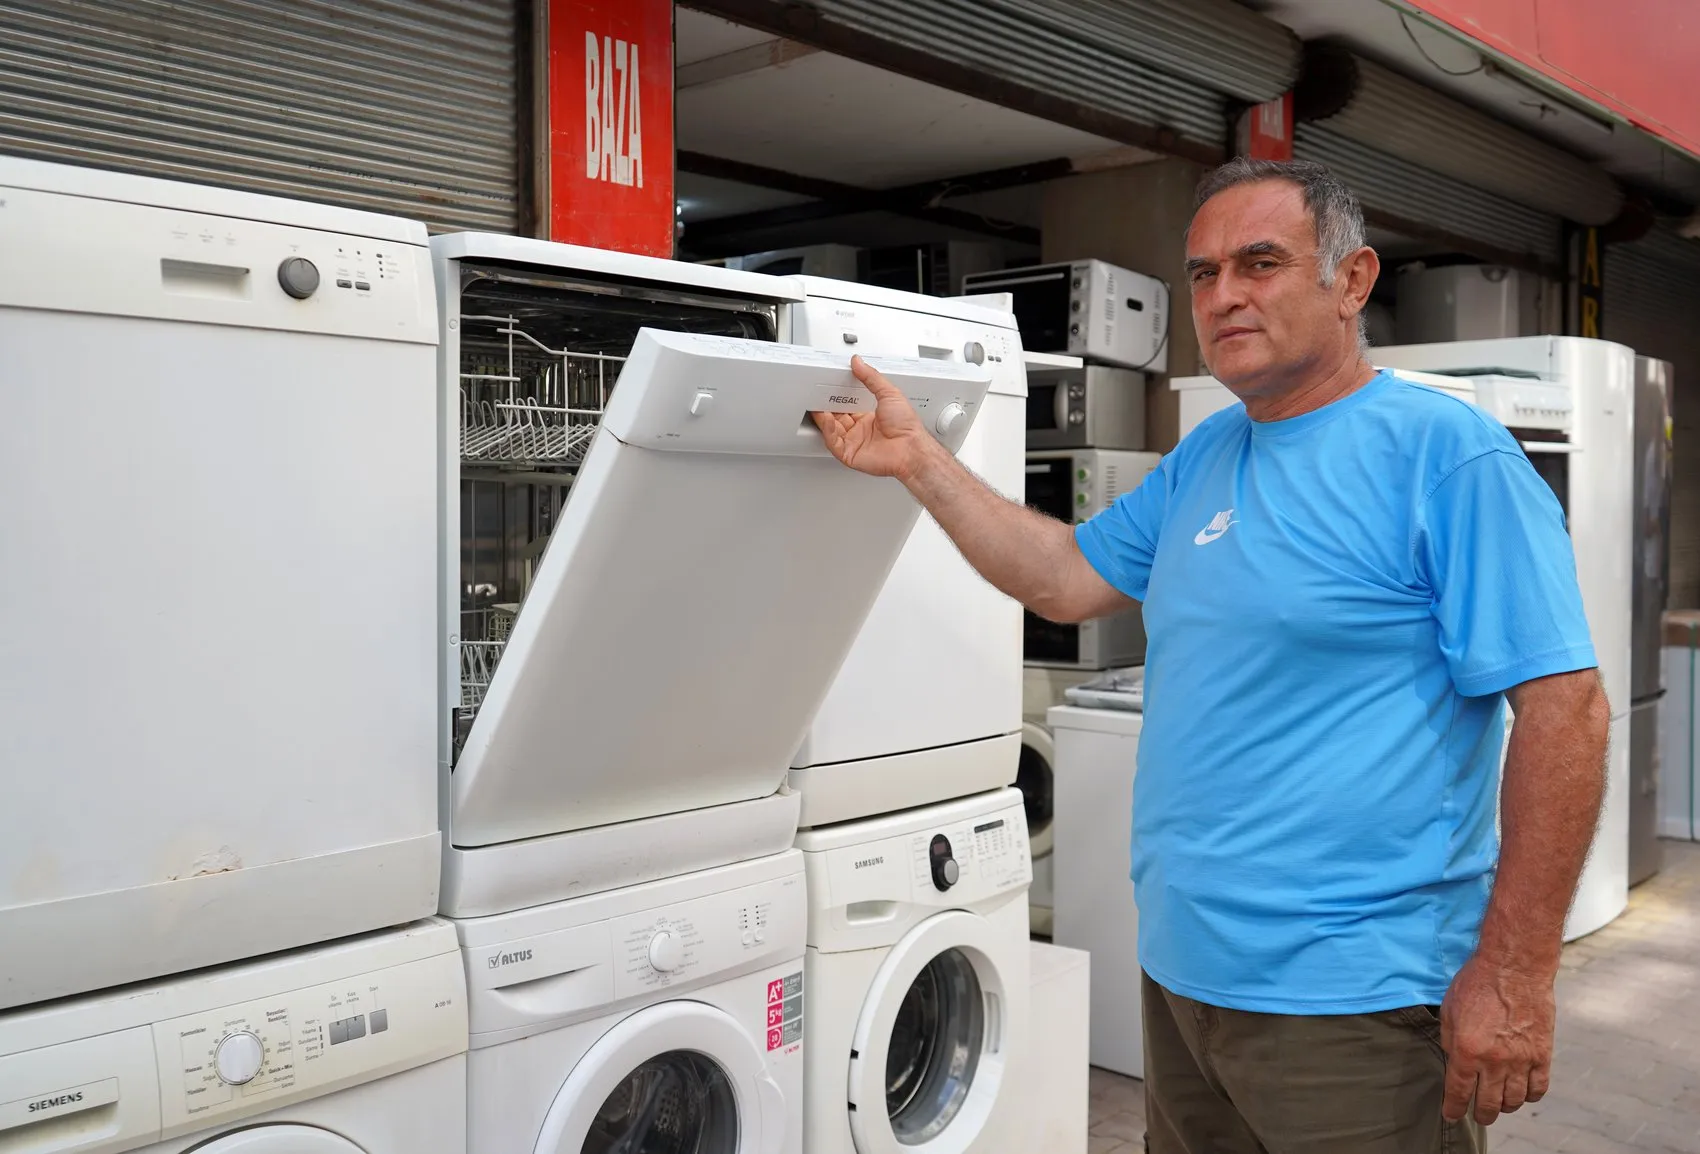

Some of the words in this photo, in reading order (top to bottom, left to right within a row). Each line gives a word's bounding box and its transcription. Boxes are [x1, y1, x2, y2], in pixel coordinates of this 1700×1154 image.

[585, 31, 643, 188] BAZA
[828, 395, 858, 404] REGAL
[854, 856, 884, 870] SAMSUNG
[501, 949, 533, 966] ALTUS
[768, 981, 782, 1003] A+
[28, 1091, 83, 1113] SIEMENS
